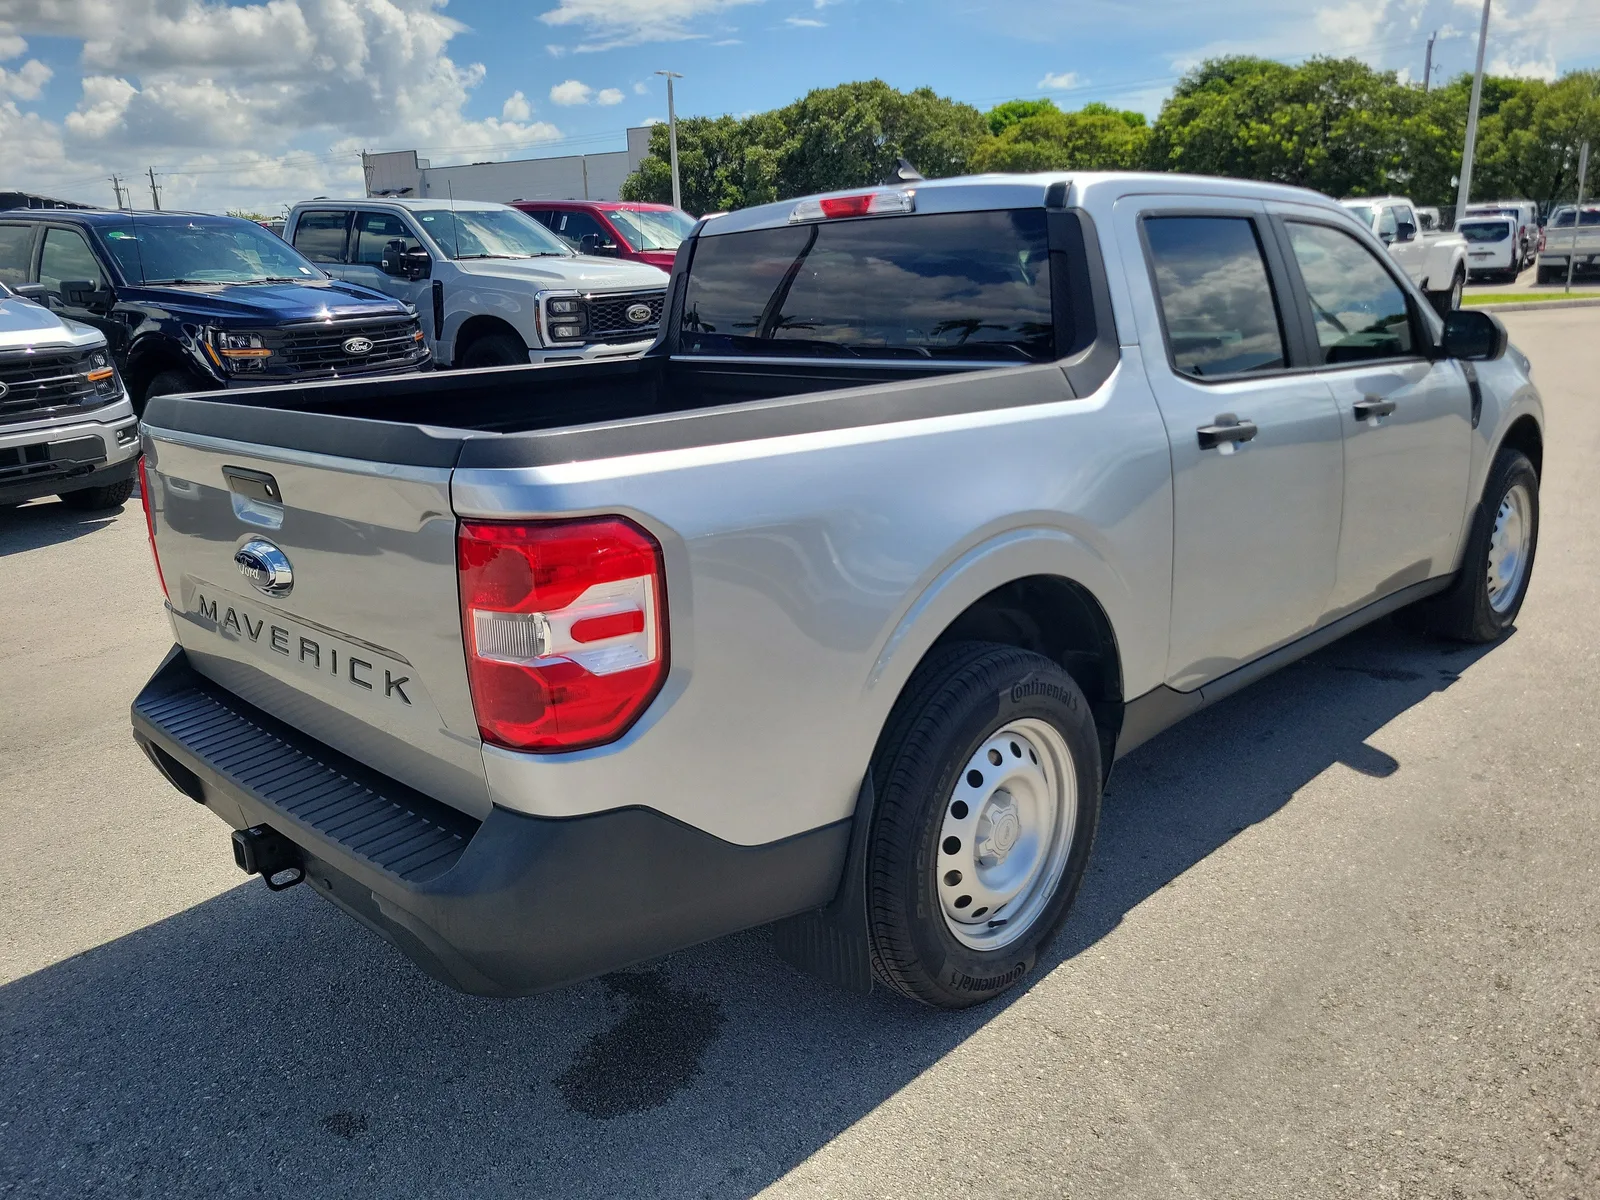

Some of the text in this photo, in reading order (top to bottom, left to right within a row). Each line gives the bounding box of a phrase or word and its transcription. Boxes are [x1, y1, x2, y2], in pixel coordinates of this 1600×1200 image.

[351, 341, 368, 351] Ford
[237, 554, 261, 581] Ford
[199, 593, 413, 707] MAVERICK
[1011, 679, 1072, 708] Continental
[955, 962, 1026, 992] Continental
